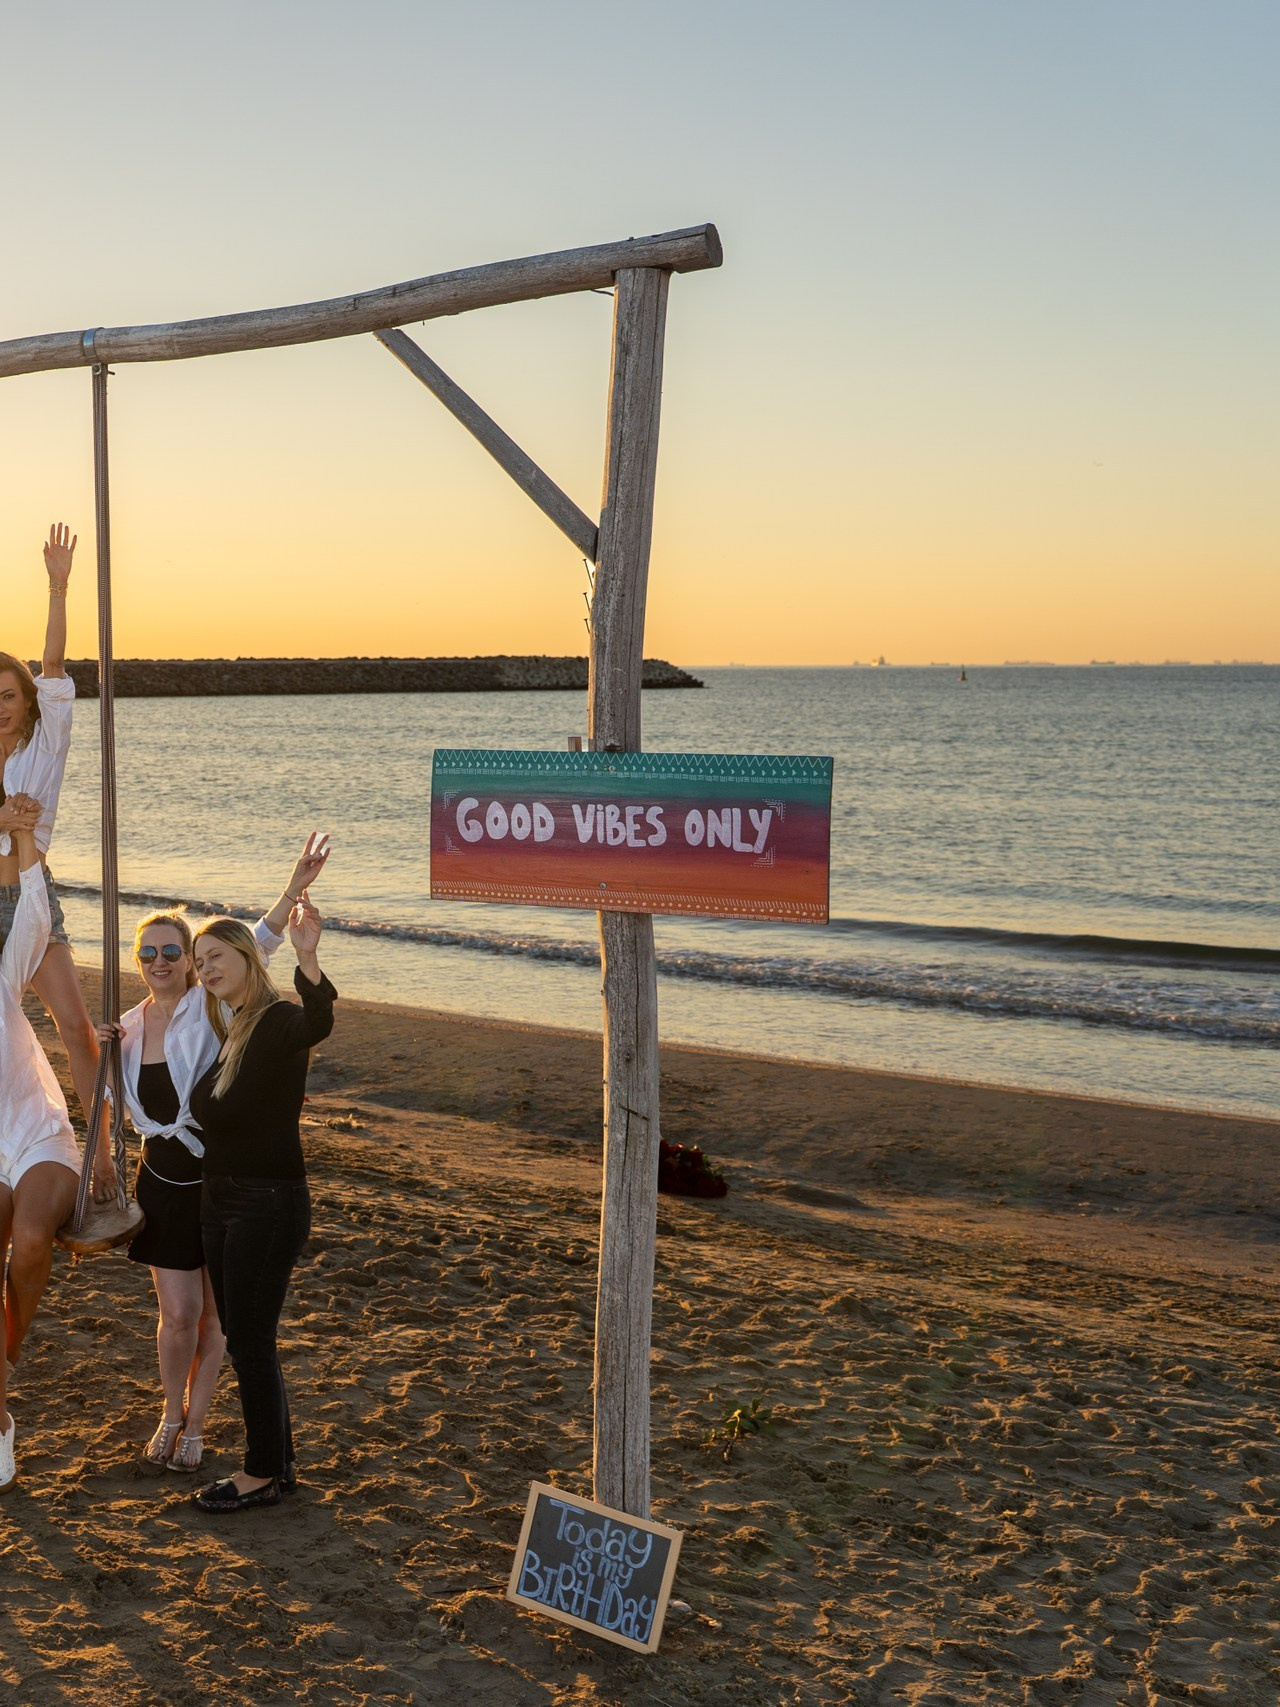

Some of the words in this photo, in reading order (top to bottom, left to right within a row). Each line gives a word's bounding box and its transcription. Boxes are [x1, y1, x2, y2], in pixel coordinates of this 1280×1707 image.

[456, 798, 555, 842] GOOD
[685, 807, 772, 854] ONLY
[549, 1498, 653, 1569] Today
[571, 1546, 594, 1576] is
[597, 1556, 634, 1589] my
